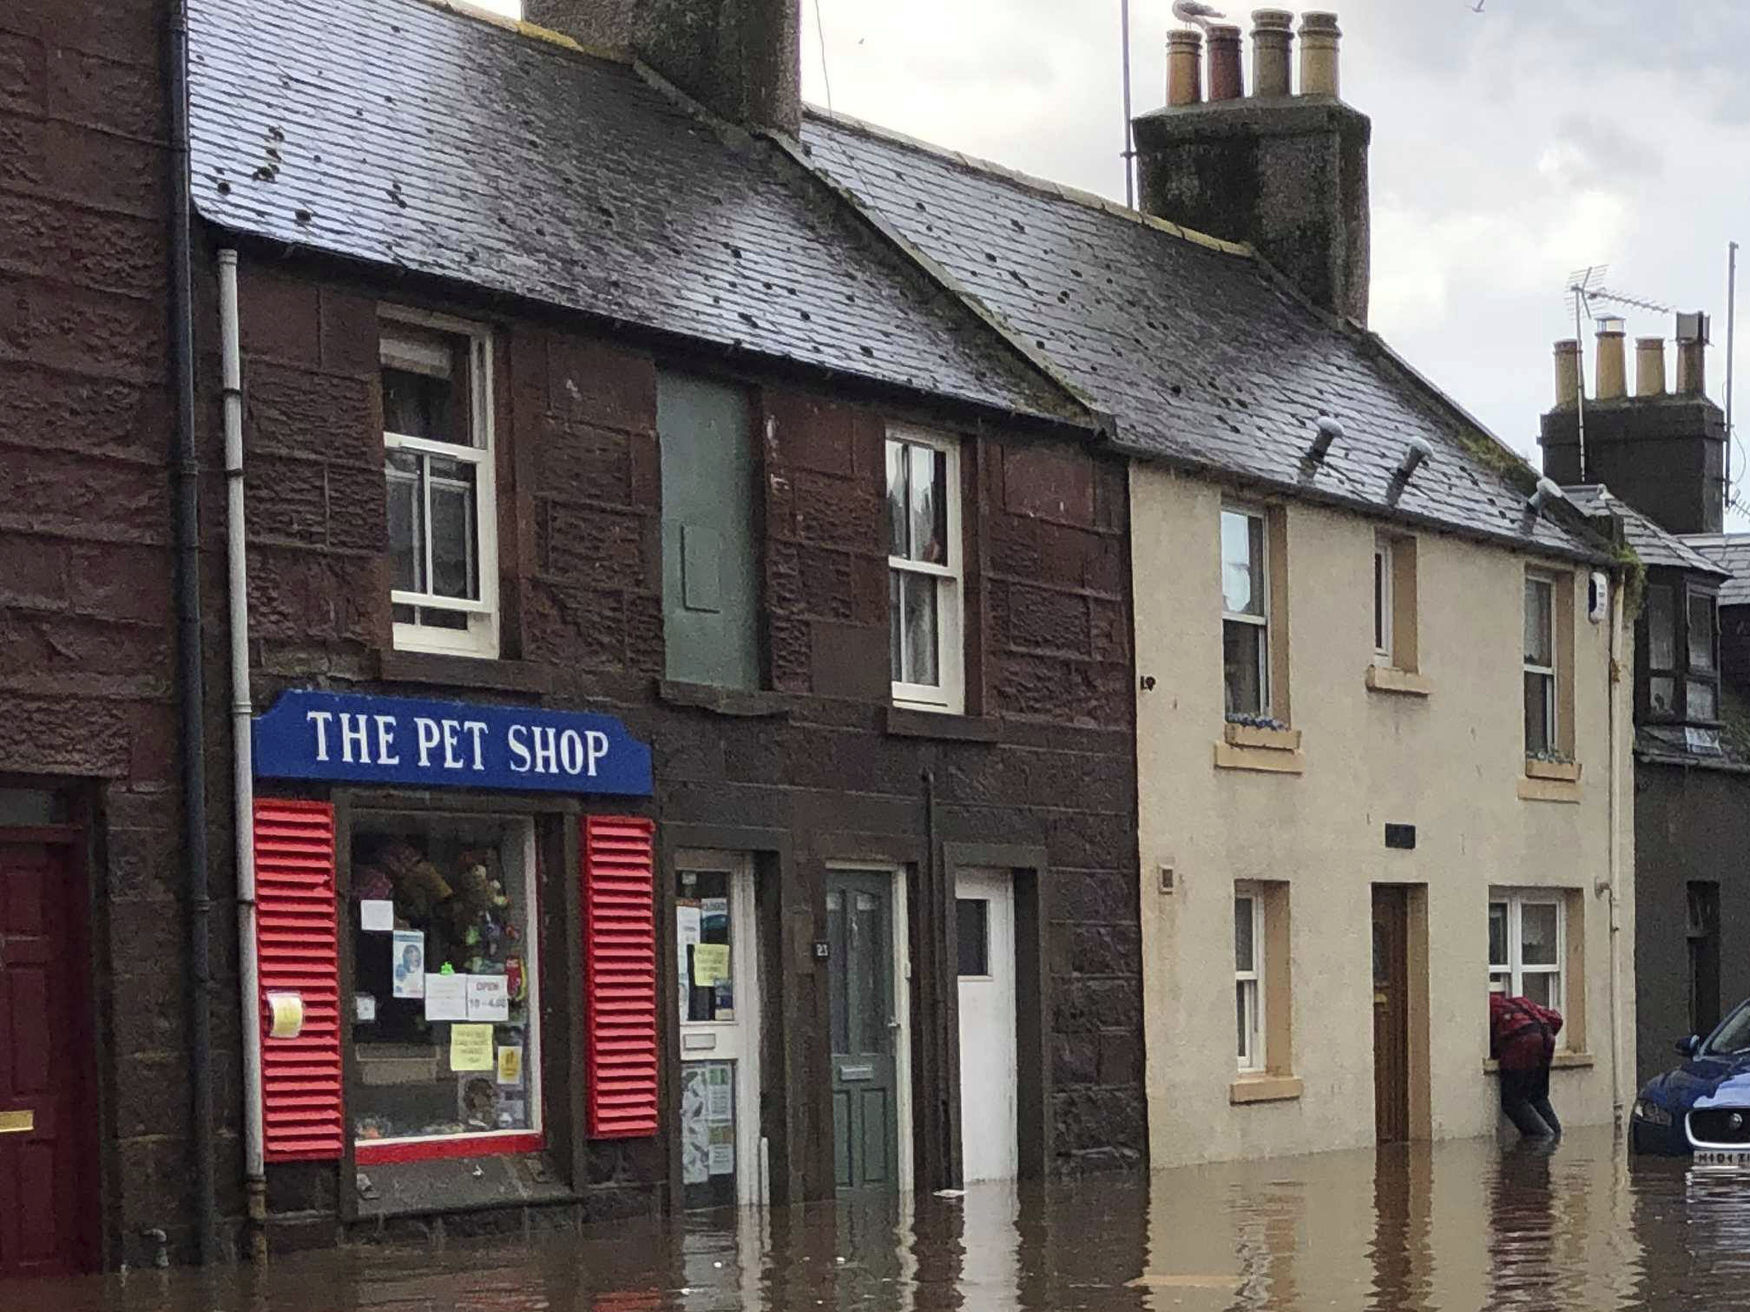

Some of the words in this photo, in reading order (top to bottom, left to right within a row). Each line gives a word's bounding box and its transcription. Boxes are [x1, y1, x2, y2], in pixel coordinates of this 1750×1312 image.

[307, 710, 399, 765] THE
[413, 717, 488, 771] PET
[507, 725, 608, 776] SHOP
